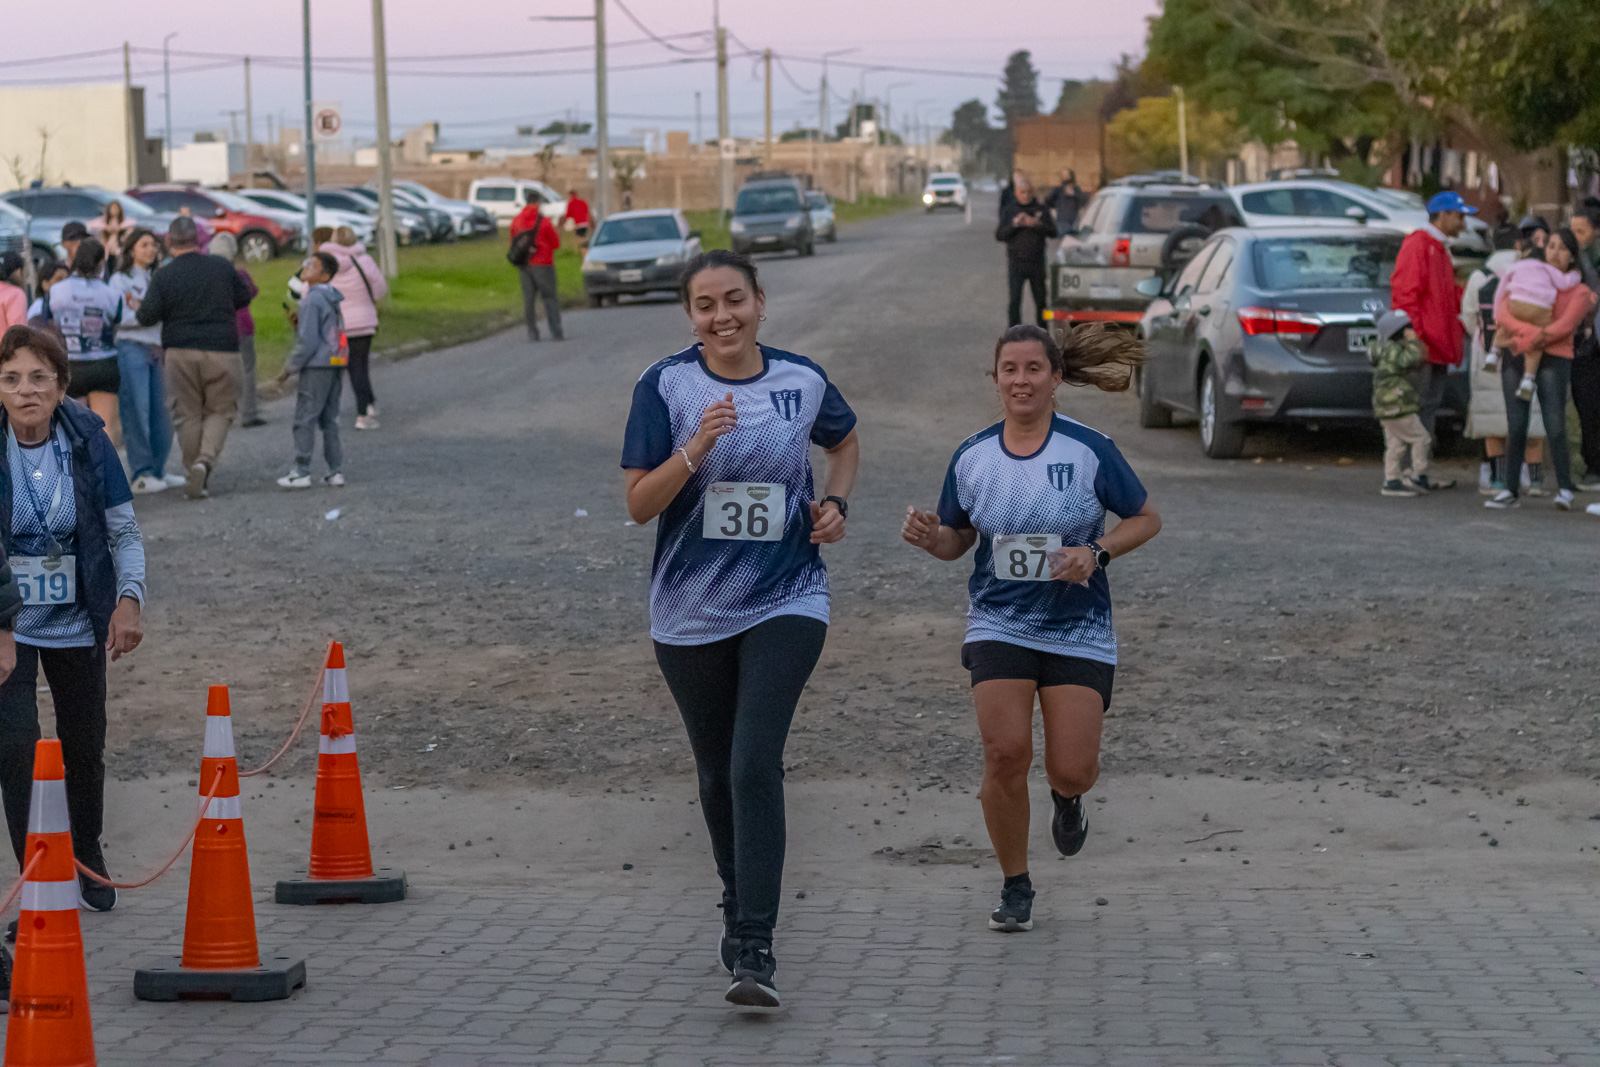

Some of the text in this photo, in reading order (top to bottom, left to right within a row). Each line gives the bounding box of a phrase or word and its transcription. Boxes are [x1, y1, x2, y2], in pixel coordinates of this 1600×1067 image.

[775, 391, 797, 400] SFC
[1051, 465, 1070, 473] SFC
[720, 502, 769, 537] 36
[1009, 549, 1047, 578] 87
[12, 572, 68, 602] 519
